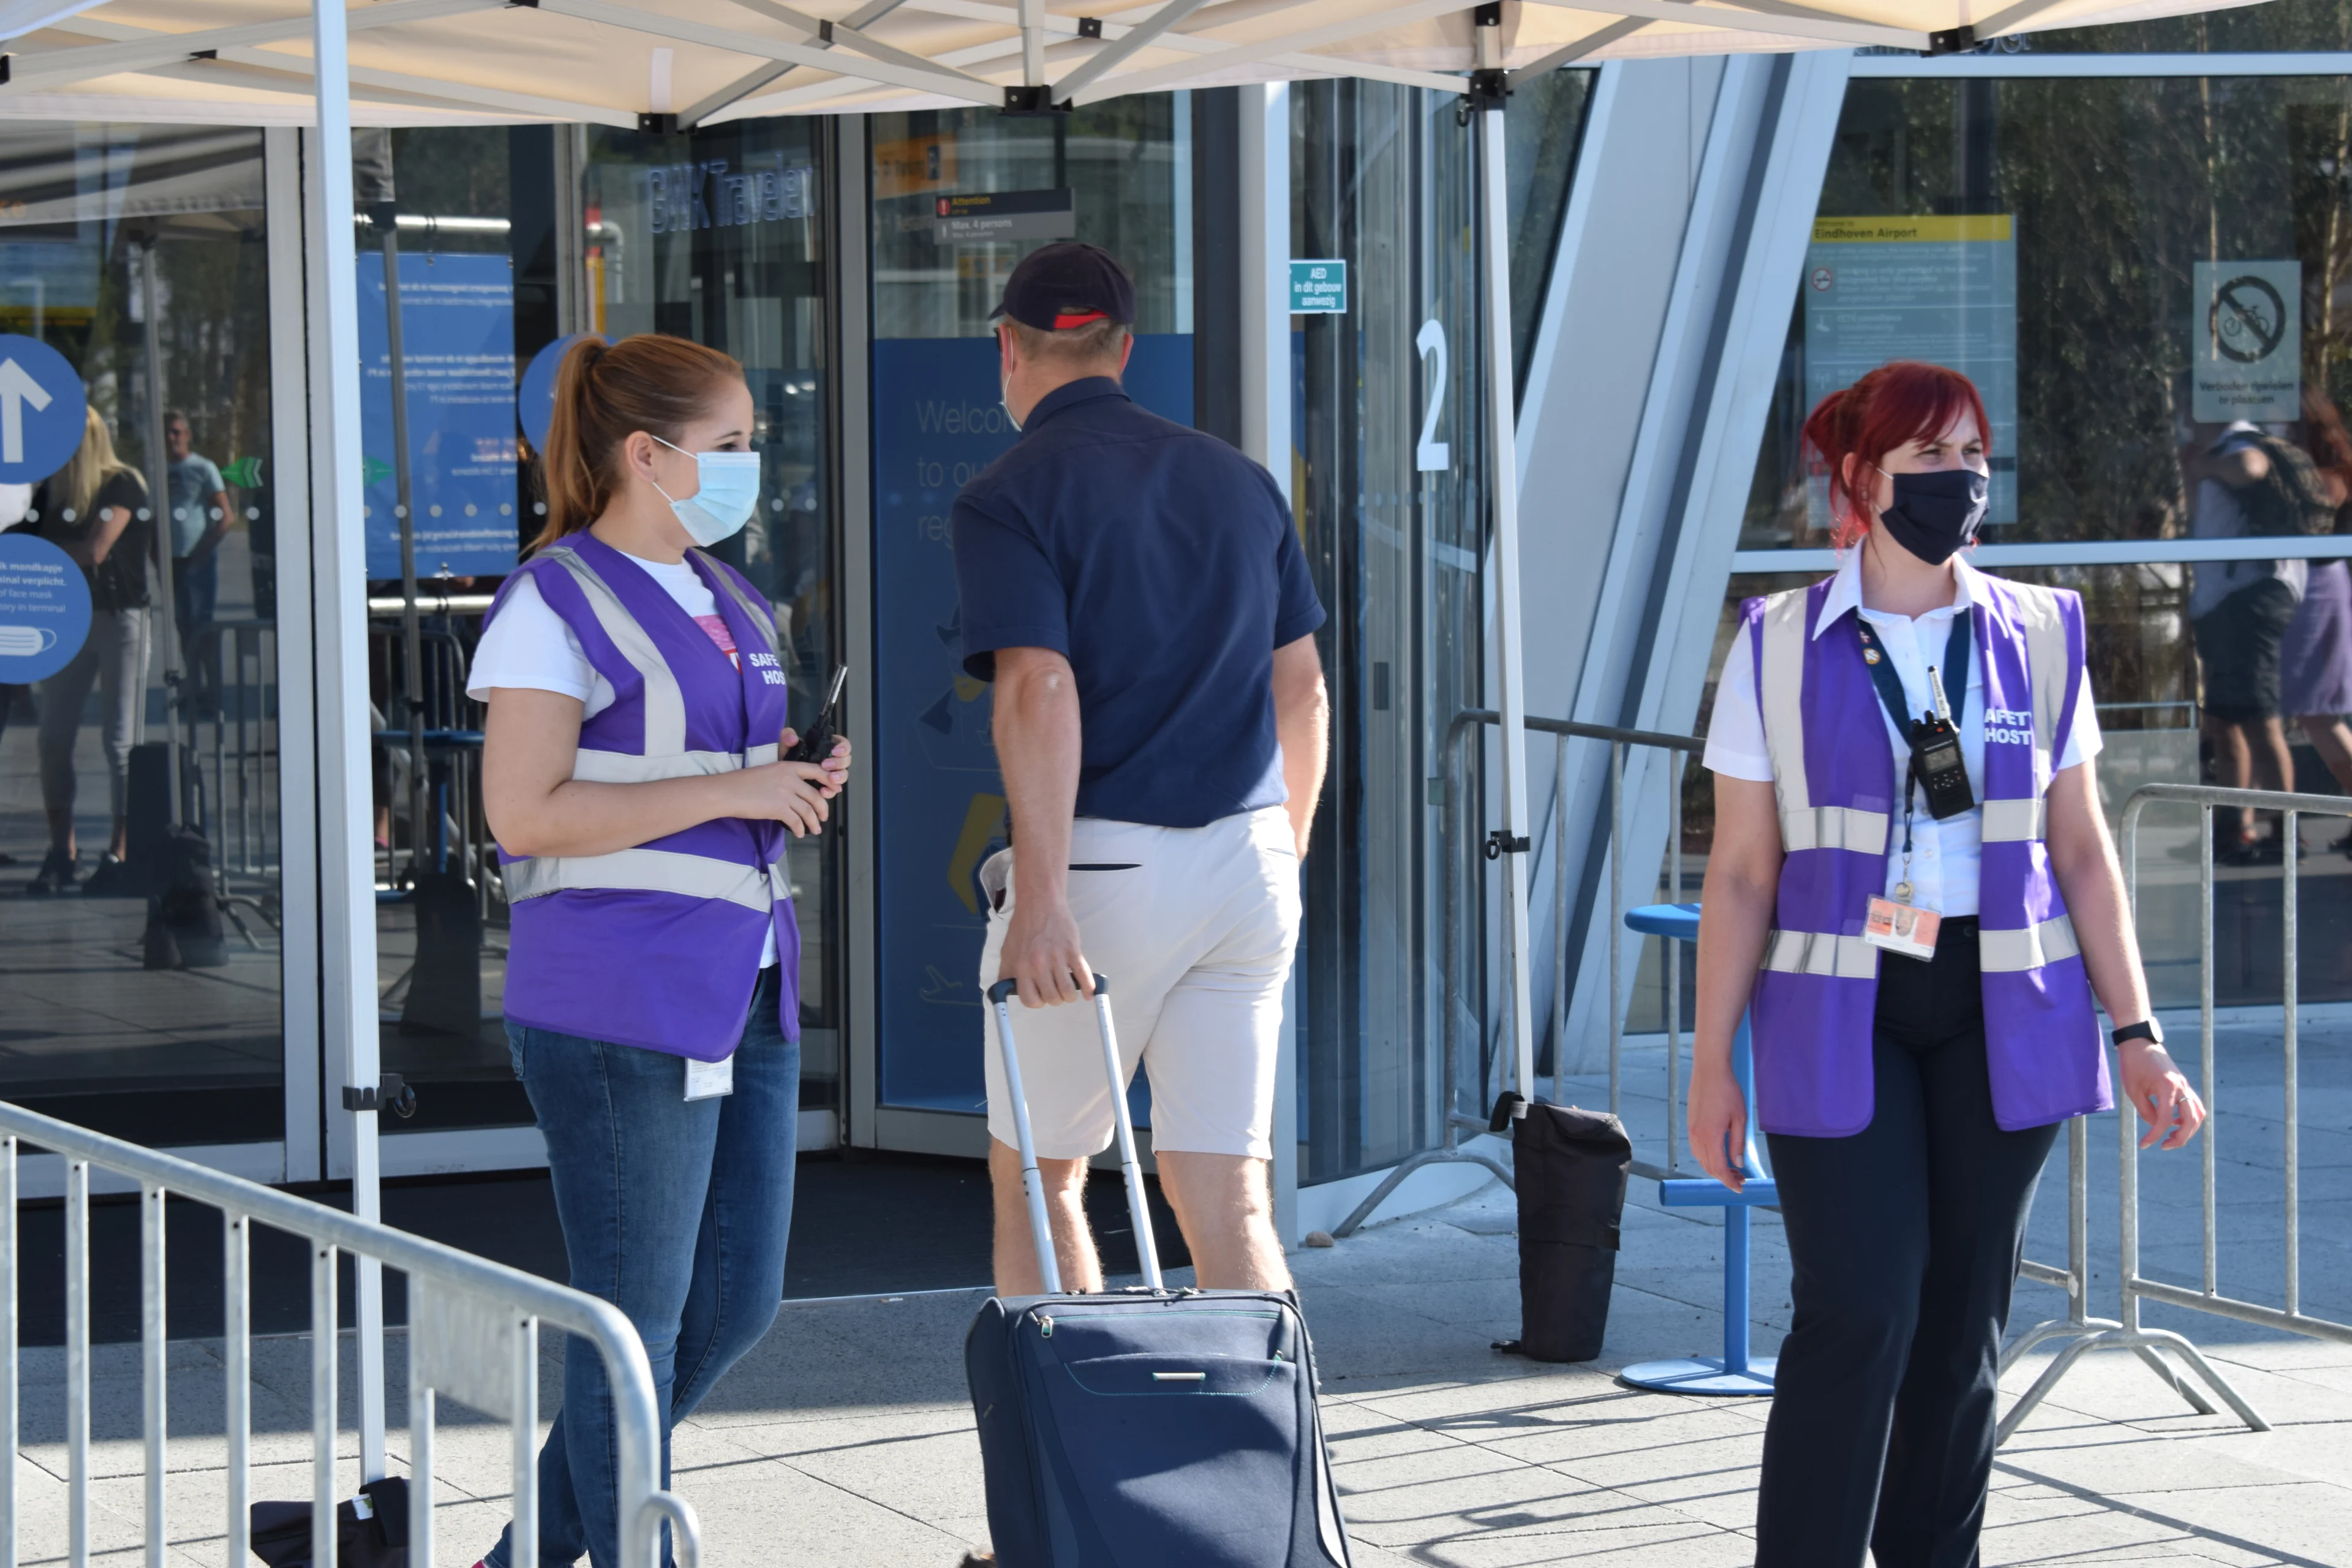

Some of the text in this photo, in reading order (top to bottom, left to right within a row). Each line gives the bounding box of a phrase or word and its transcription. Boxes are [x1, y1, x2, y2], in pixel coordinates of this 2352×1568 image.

[708, 153, 815, 227] Travelex
[952, 197, 991, 206] Attention
[951, 219, 1012, 230] Max. 4 persons
[1815, 227, 1917, 240] Eindhoven Airport
[1310, 268, 1327, 279] AED
[1294, 281, 1341, 295] in dit gebouw
[1301, 295, 1336, 308] aanwezig
[2199, 381, 2248, 392] Verboden
[1415, 318, 1449, 472] 2
[2218, 396, 2229, 405] te
[915, 399, 1016, 434] Welco
[916, 456, 943, 488] to
[10, 562, 64, 575] mondkapje
[22, 577, 67, 587] verplicht.
[9, 589, 28, 598] face
[29, 590, 53, 599] mask
[29, 604, 66, 612] terminal
[749, 652, 782, 668] SAFE
[762, 669, 786, 685] HOS
[1984, 708, 2033, 726] AFET
[1984, 728, 2032, 745] HOST
